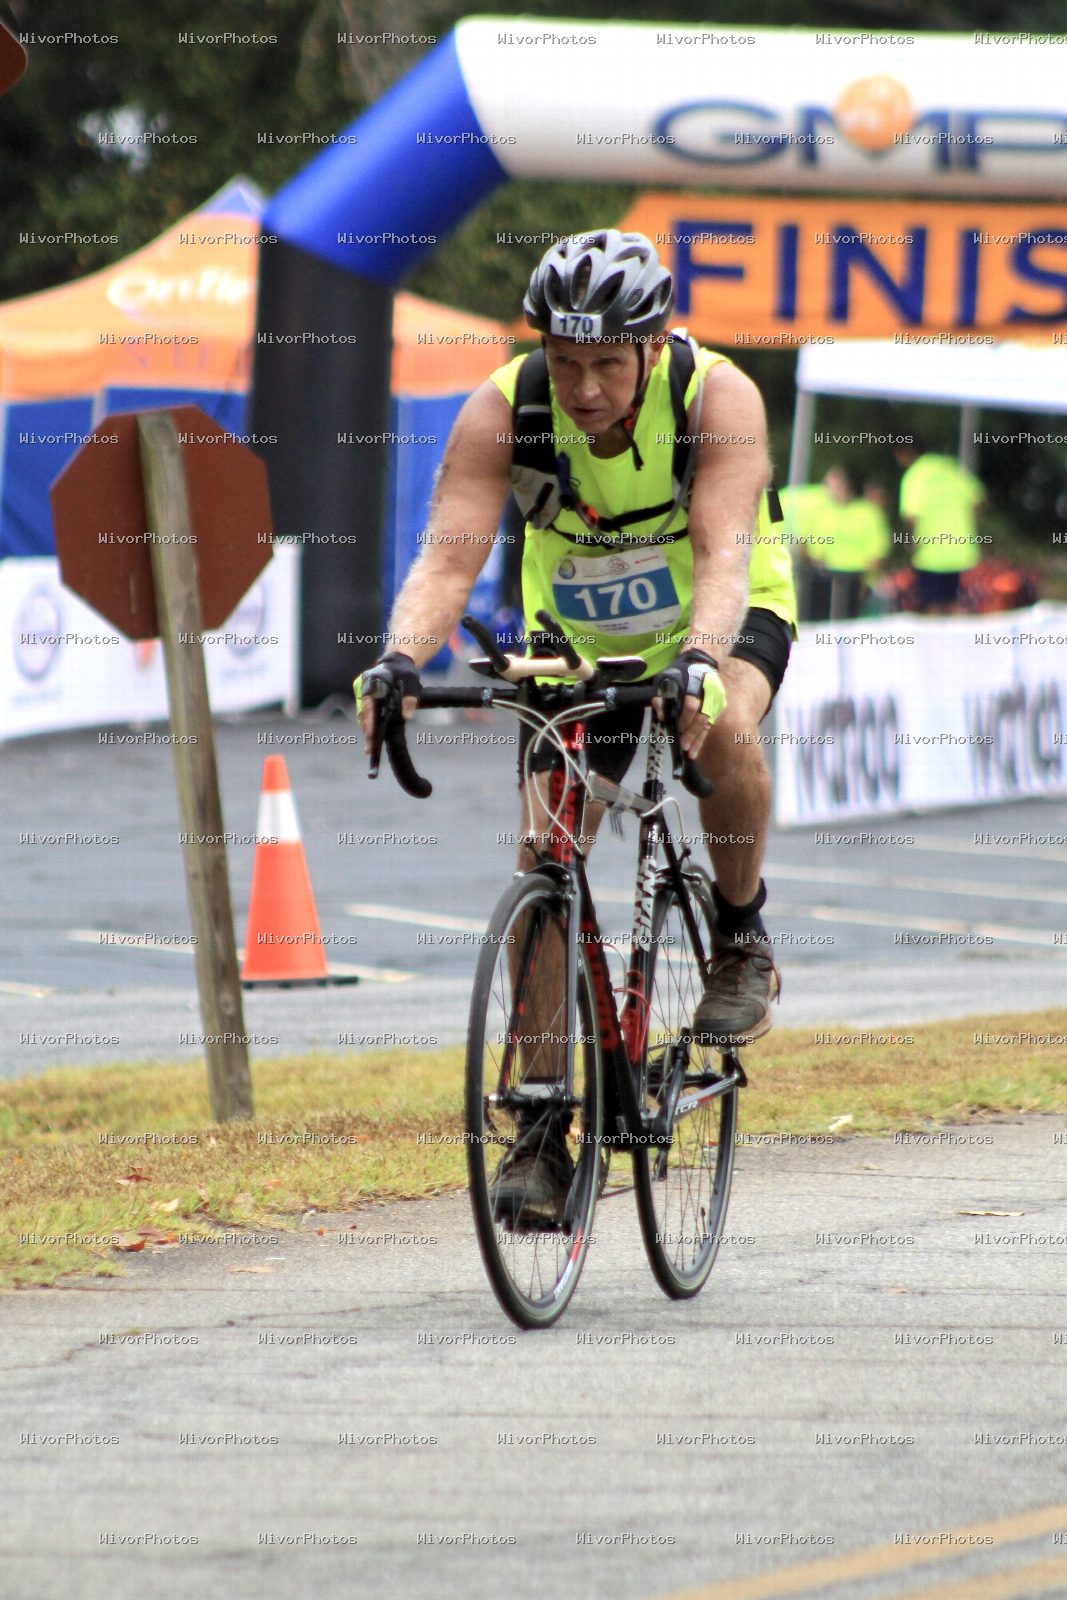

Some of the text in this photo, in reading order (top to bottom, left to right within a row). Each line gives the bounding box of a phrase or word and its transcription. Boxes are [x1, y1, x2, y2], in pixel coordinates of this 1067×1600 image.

[671, 219, 1067, 329] FINIS
[559, 315, 594, 334] 170
[574, 577, 657, 619] 170
